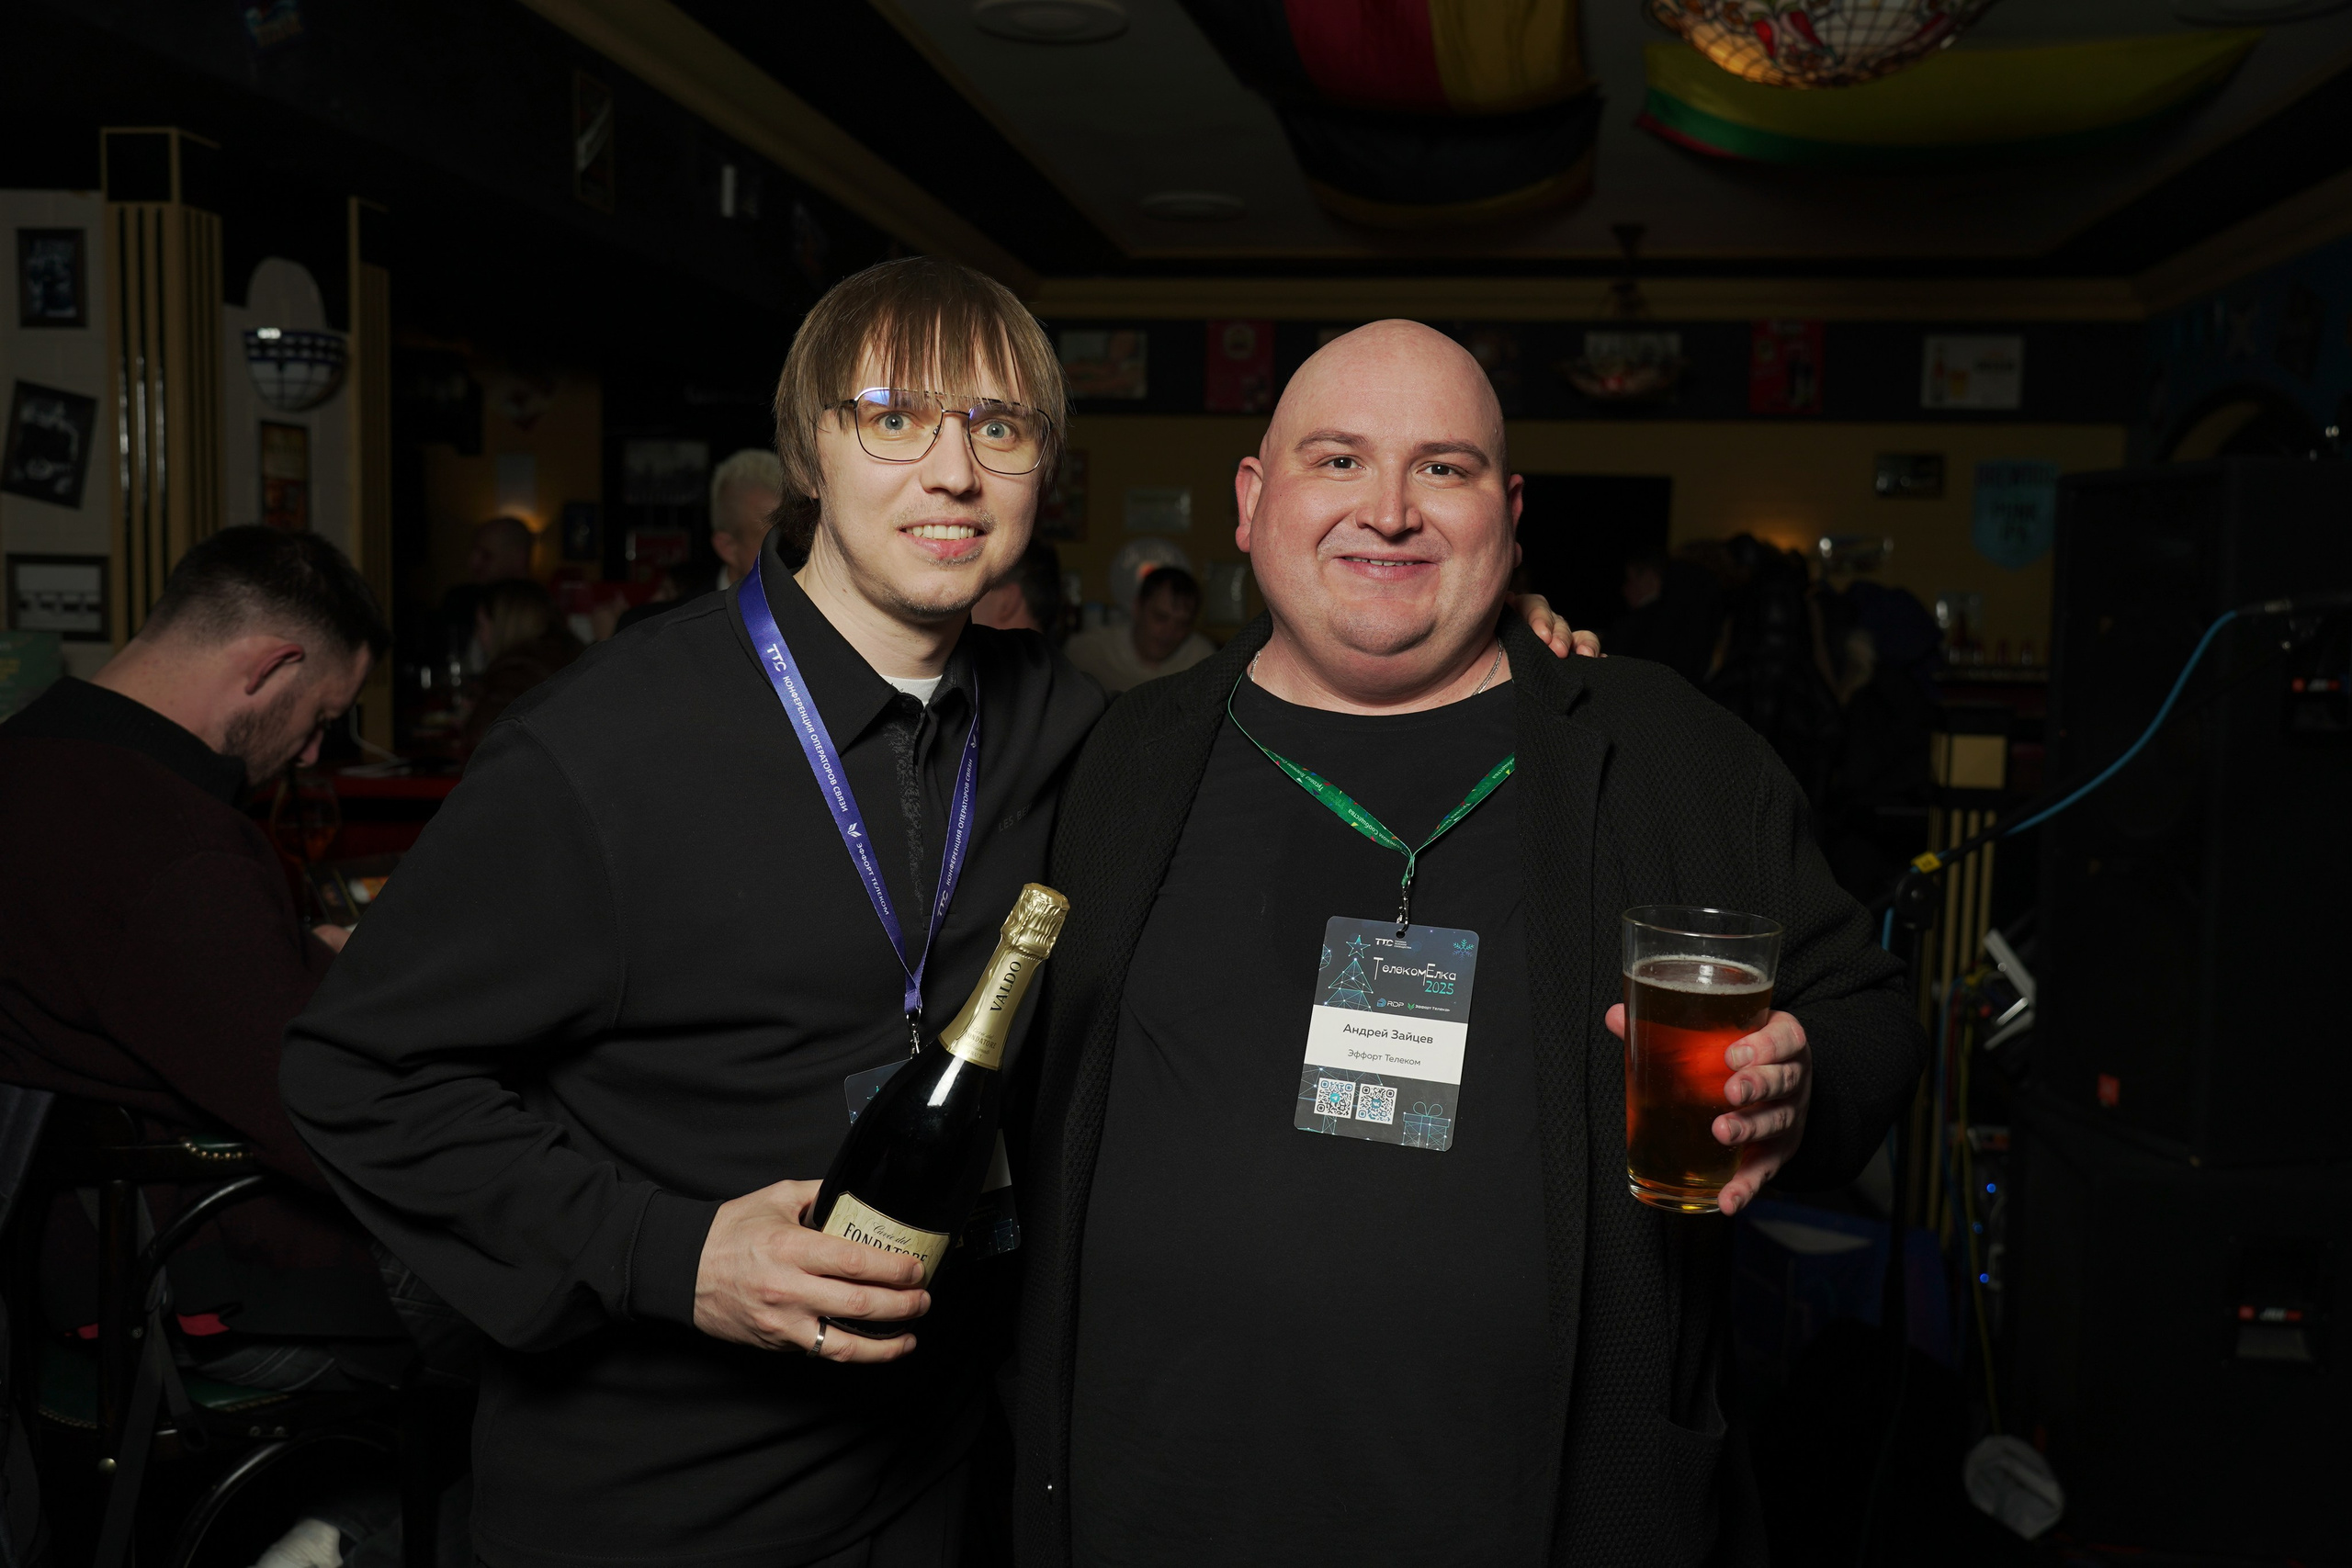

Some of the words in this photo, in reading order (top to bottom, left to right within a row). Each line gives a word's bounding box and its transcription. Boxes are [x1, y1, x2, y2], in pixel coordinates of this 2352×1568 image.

[783, 675, 815, 733] КОНФЕРЕНЦИЯ
[810, 734, 837, 785] ОПЕРАТОРОВ
[832, 786, 848, 812] СВЯЗИ
[946, 830, 963, 886] КОНФЕРЕНЦИЯ
[957, 782, 970, 829] ОПЕРАТОРОВ
[1348, 808, 1379, 836] Сообщества
[856, 842, 874, 875] ЭФФОРТ
[871, 877, 889, 916] ТЕЛЕКОМ
[990, 961, 1022, 1011] VALDO
[1424, 980, 1454, 995] 2025
[1343, 1023, 1388, 1038] Андрей
[1391, 1029, 1433, 1044] Зайцев
[1348, 1049, 1383, 1061] Эффорт
[1385, 1054, 1421, 1066] Телеком
[843, 1222, 928, 1262] FONDE
